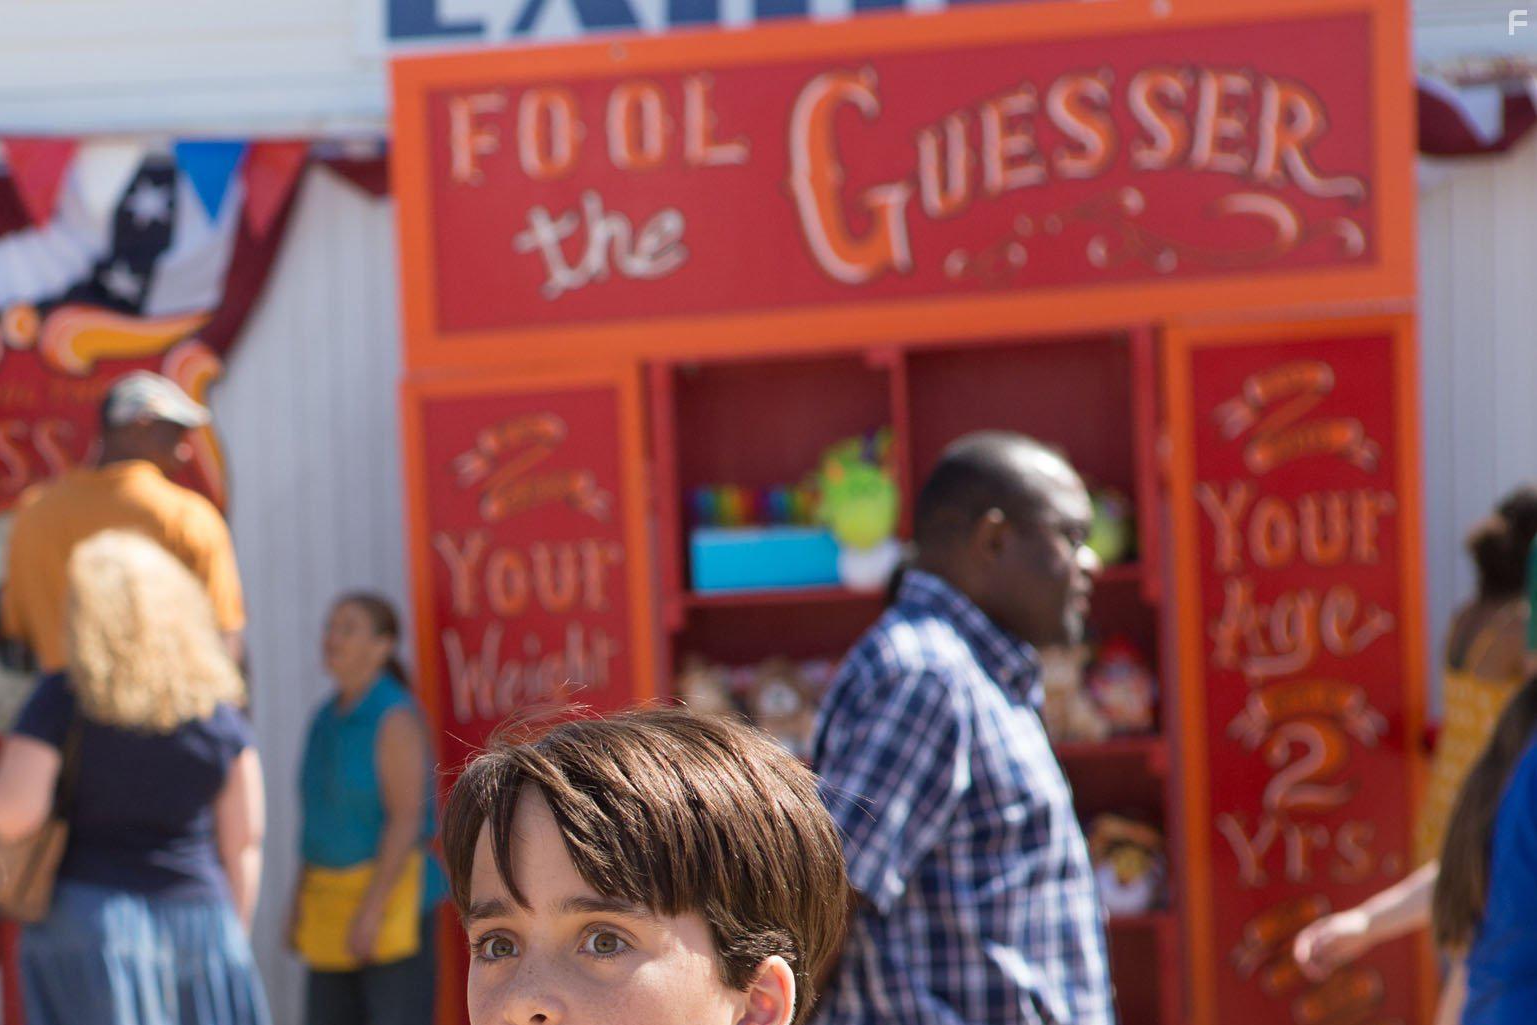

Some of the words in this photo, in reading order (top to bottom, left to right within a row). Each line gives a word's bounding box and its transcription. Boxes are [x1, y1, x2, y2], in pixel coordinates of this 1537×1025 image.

[447, 73, 751, 185] FOOL
[785, 64, 1366, 286] GUESSER
[512, 189, 691, 301] the
[434, 529, 625, 619] Your
[1194, 480, 1399, 570] Your
[1262, 720, 1352, 810] 2
